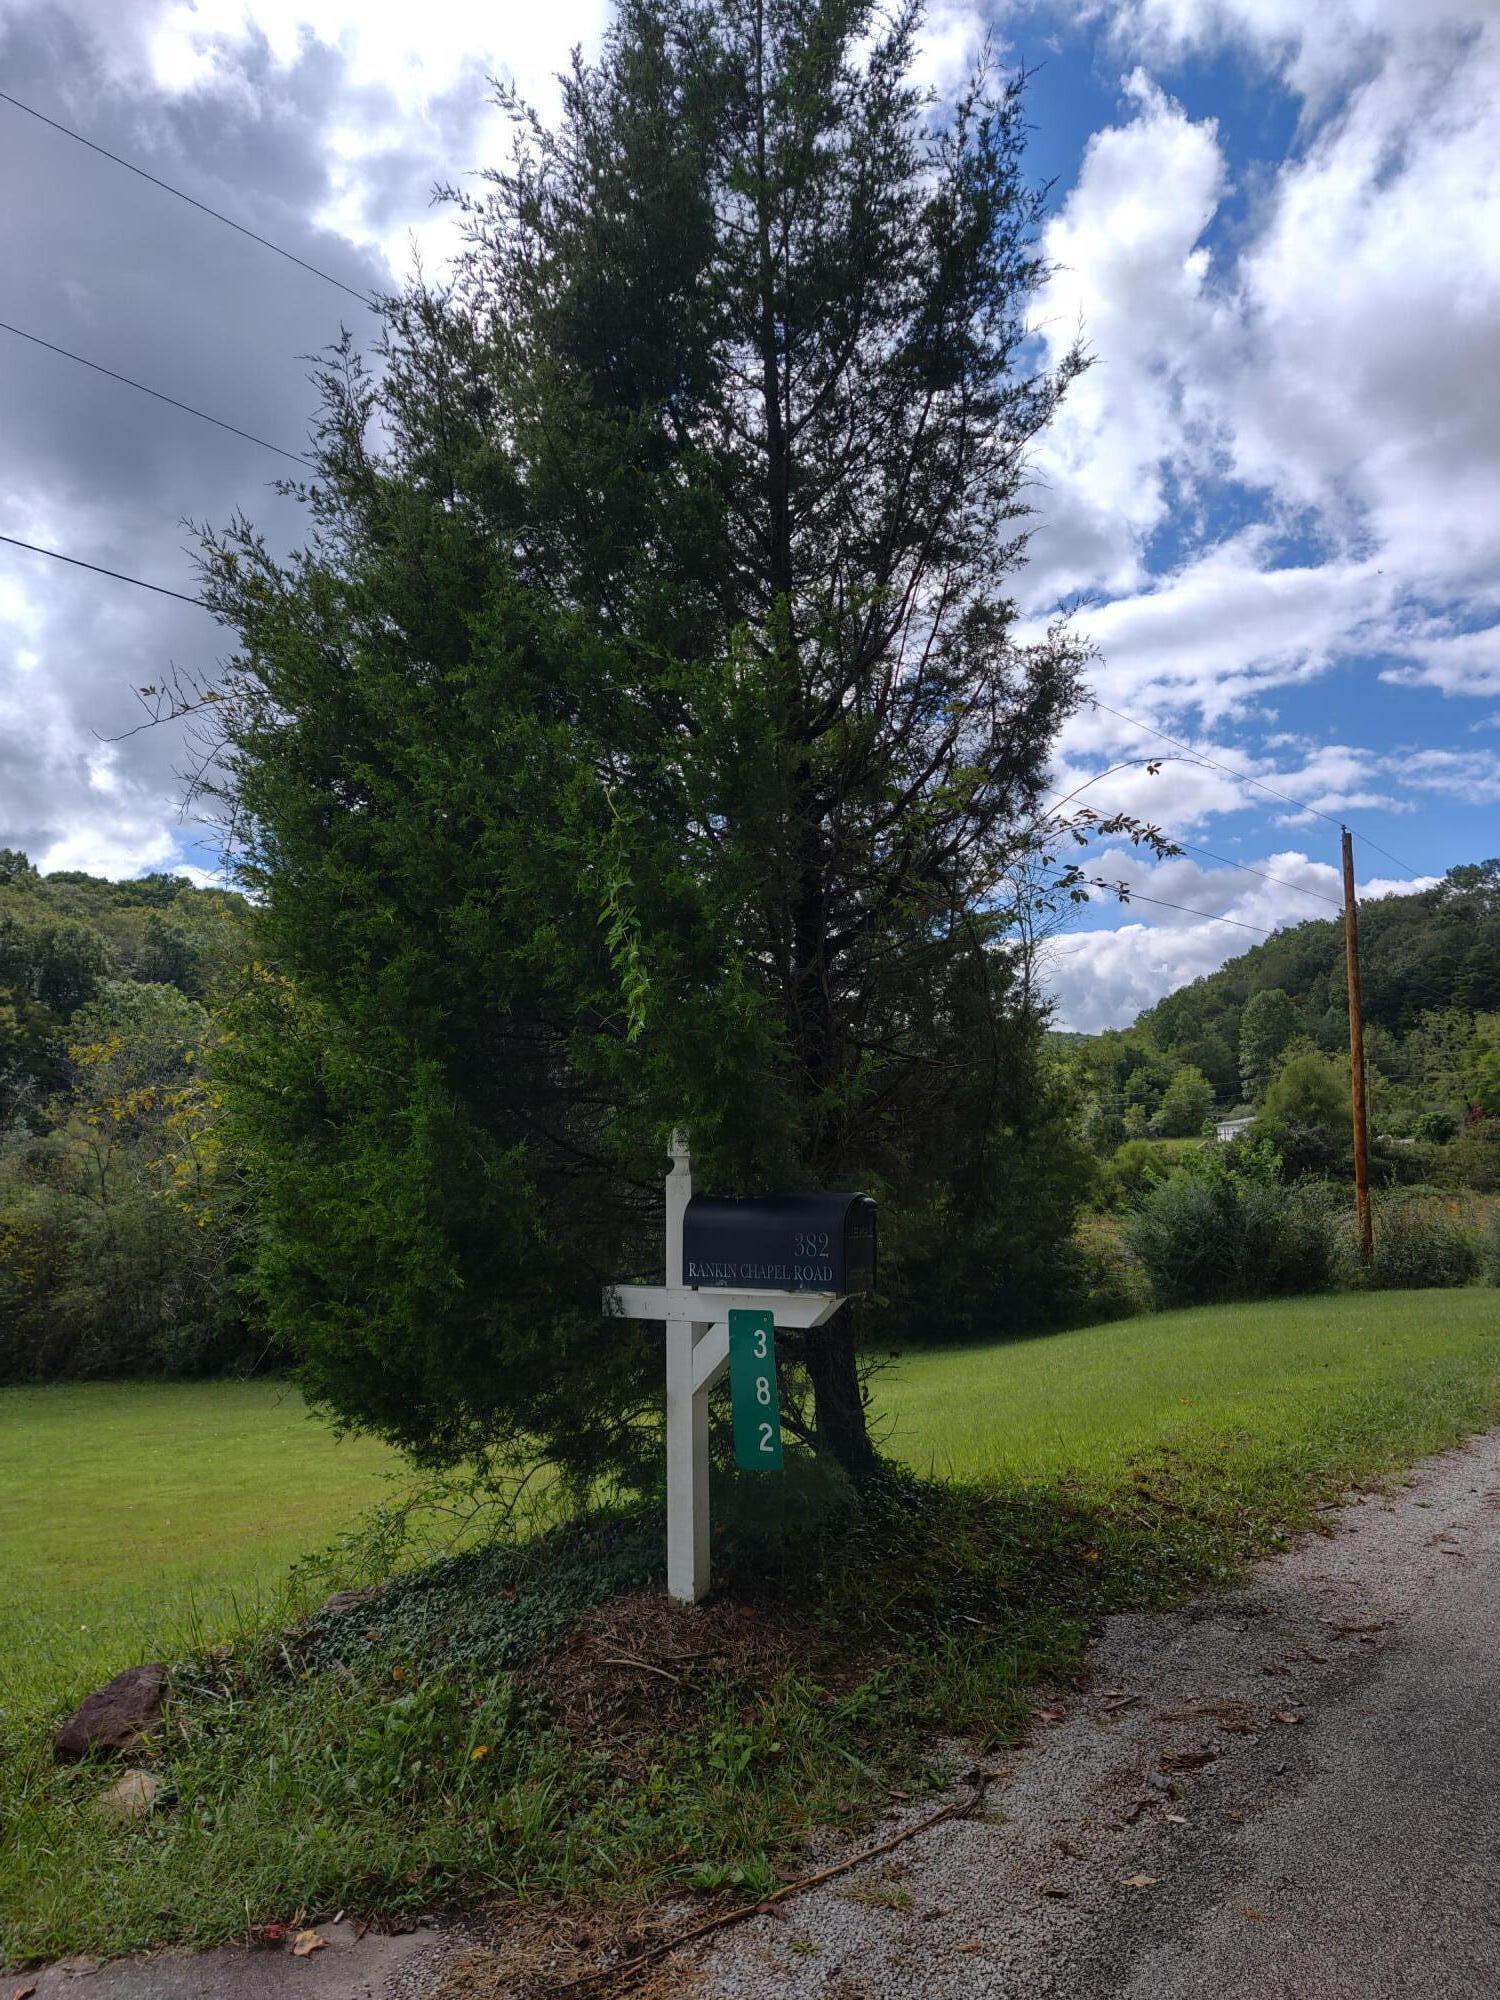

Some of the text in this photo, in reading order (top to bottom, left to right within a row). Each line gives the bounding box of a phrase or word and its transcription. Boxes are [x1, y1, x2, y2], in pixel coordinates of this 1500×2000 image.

[794, 1232, 829, 1258] 382
[688, 1262, 833, 1281] RANKIN CHAPEL ROAD
[753, 1329, 774, 1452] 382
